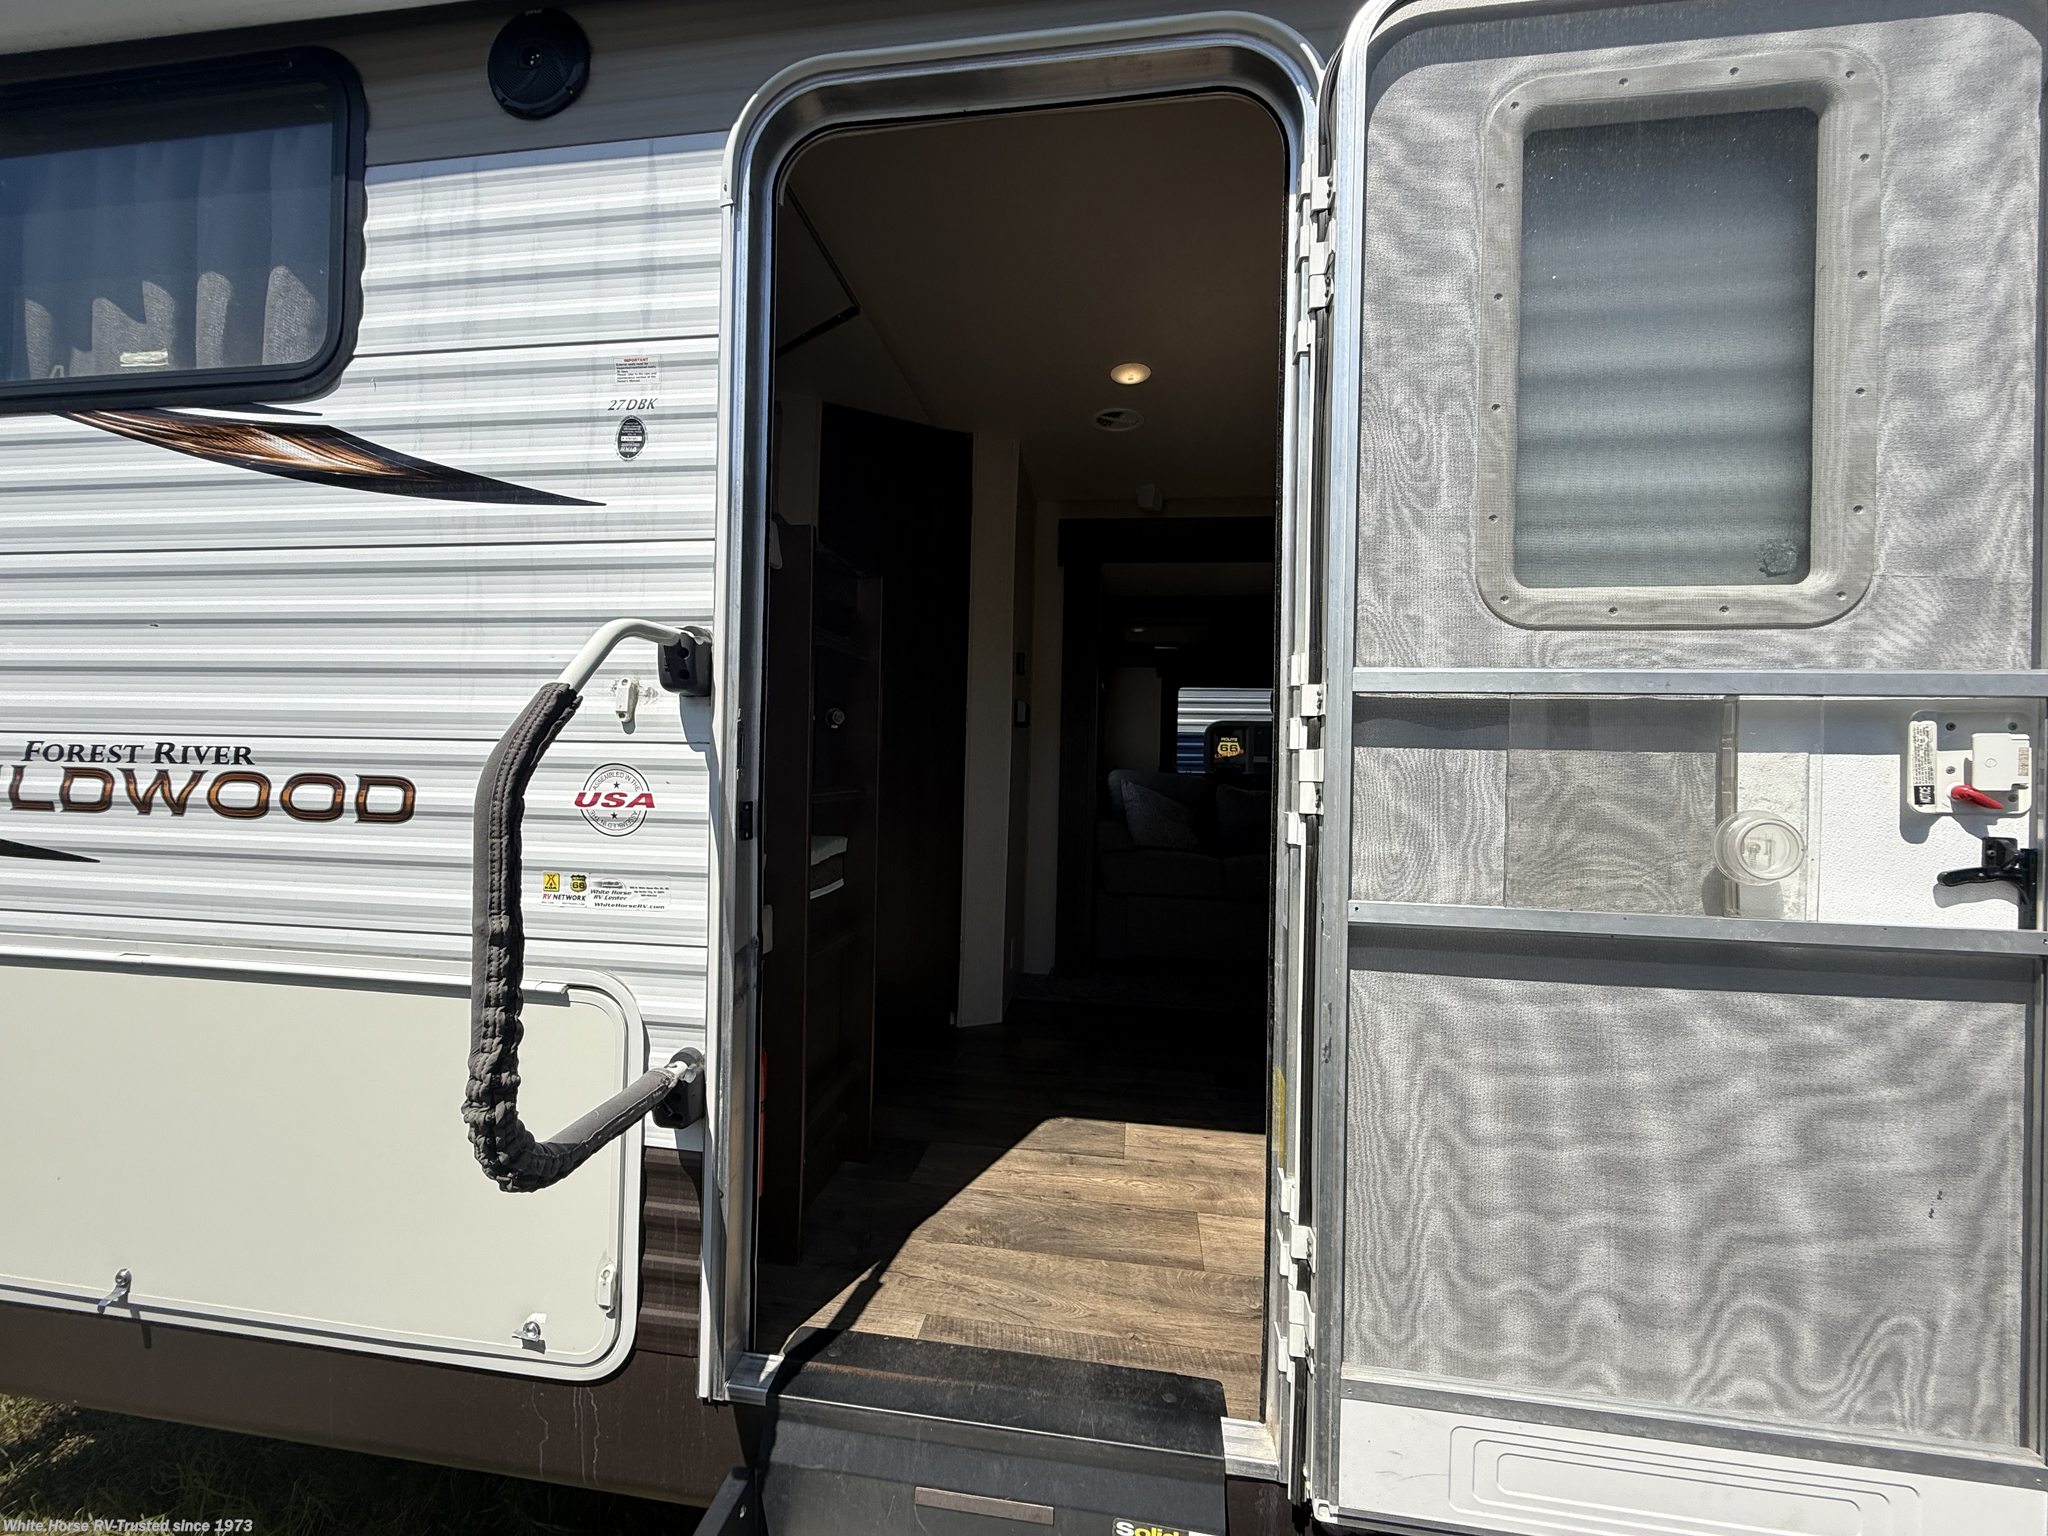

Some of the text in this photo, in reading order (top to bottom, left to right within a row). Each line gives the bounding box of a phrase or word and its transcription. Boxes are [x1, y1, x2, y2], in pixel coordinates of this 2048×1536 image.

[607, 398, 658, 411] 27DBK
[21, 740, 256, 766] FOREST RIVER
[592, 771, 641, 792] ASSEMBLED IN THE
[0, 764, 417, 824] LDWOOD
[574, 792, 656, 809] USA
[1918, 786, 1932, 804] NOTICE
[572, 881, 585, 889] 66
[552, 893, 587, 901] NETWORK
